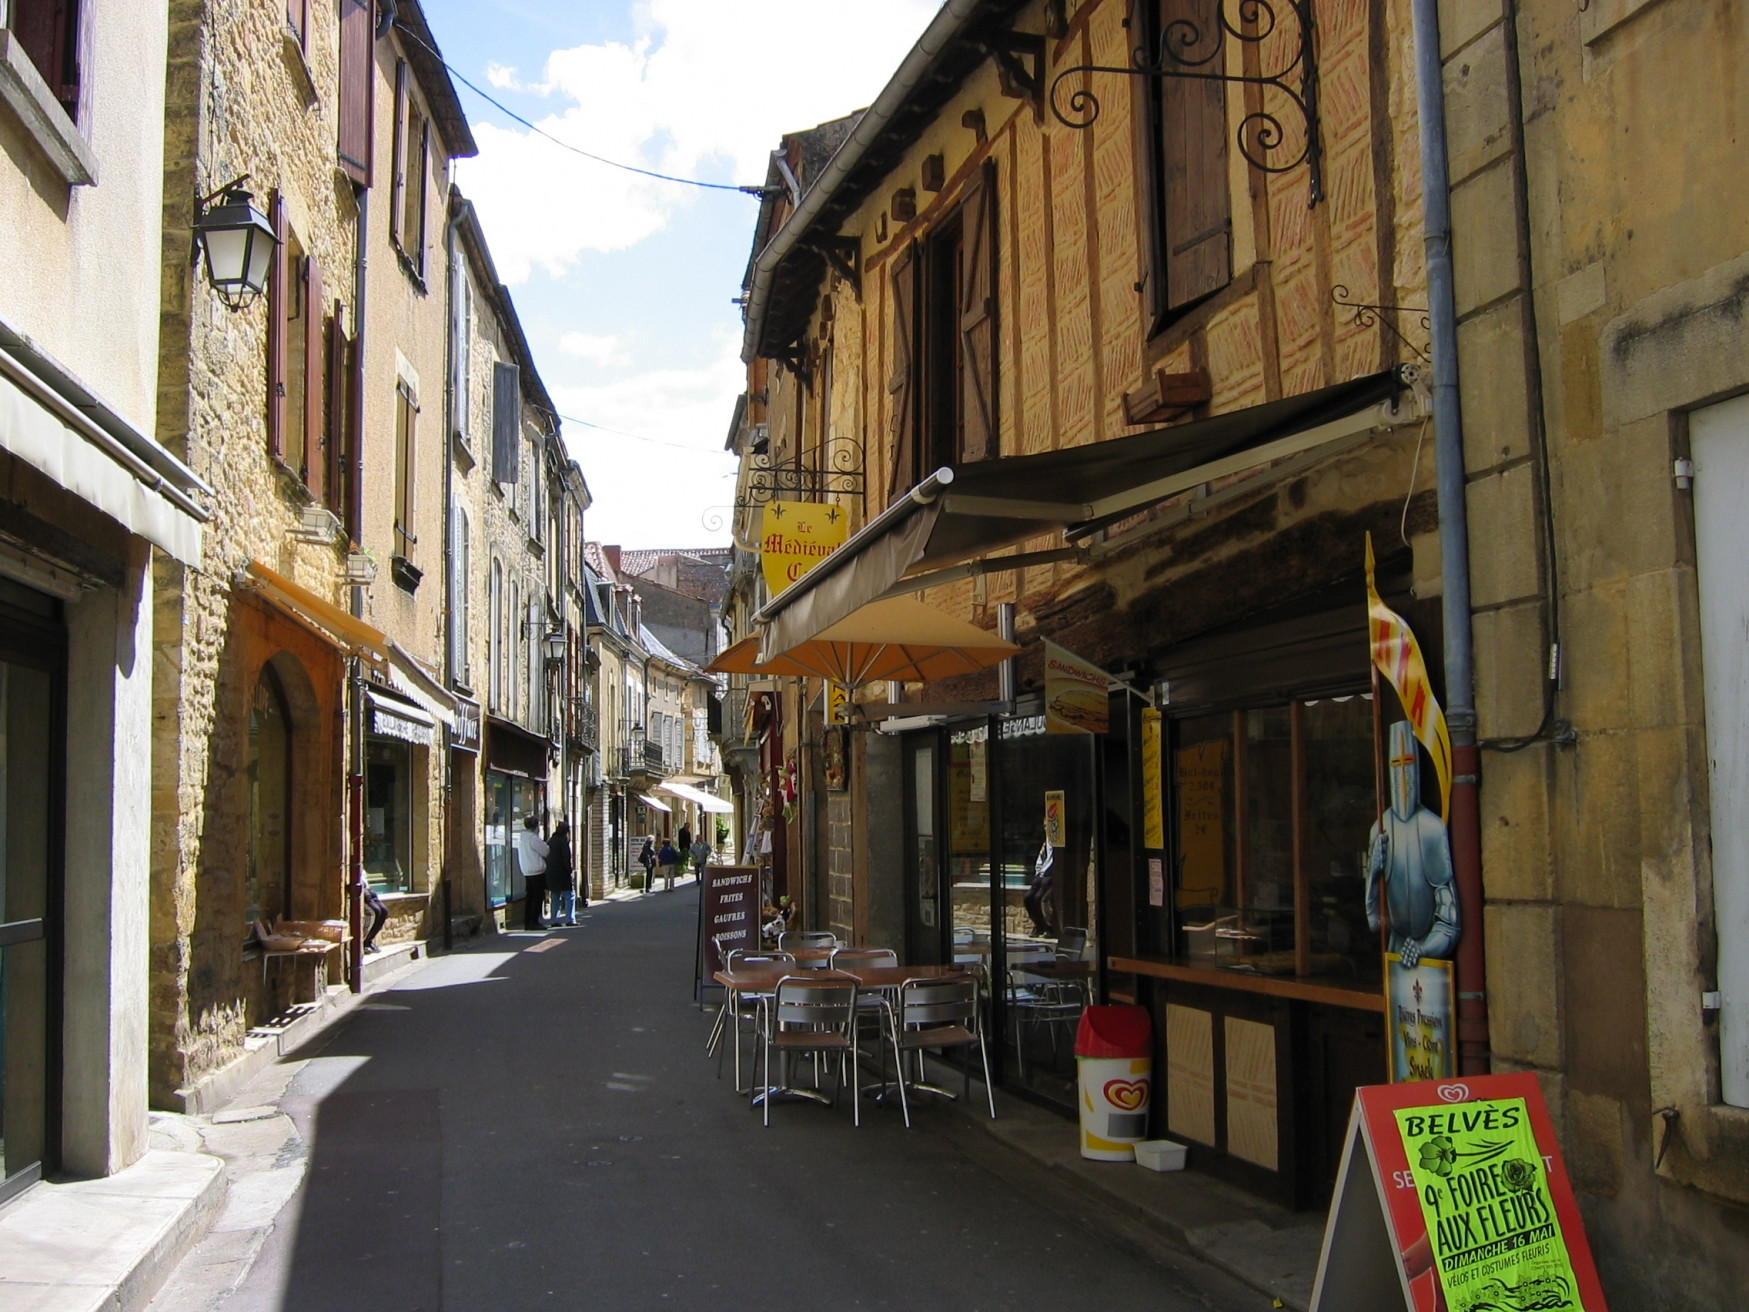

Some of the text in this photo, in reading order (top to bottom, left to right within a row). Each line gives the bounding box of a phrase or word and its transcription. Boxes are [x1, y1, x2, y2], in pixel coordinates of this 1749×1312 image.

[797, 521, 812, 534] Le
[712, 874, 753, 888] SANDWICHS
[719, 892, 744, 904] FRITES
[713, 911, 746, 924] GAUFRES
[715, 929, 747, 942] BOISSONS
[1405, 1104, 1520, 1137] BELVÈS
[1446, 1163, 1506, 1211] FOIRE
[1437, 1187, 1550, 1256] AUX FLEURS
[1444, 1241, 1509, 1271] DIMANCHE
[1512, 1234, 1526, 1248] 16
[1529, 1225, 1552, 1244] MAI
[1447, 1271, 1469, 1288] VÉLOS
[1471, 1268, 1479, 1280] ET
[1481, 1254, 1520, 1276] COSTUMES
[1521, 1243, 1550, 1262] FLEURIS
